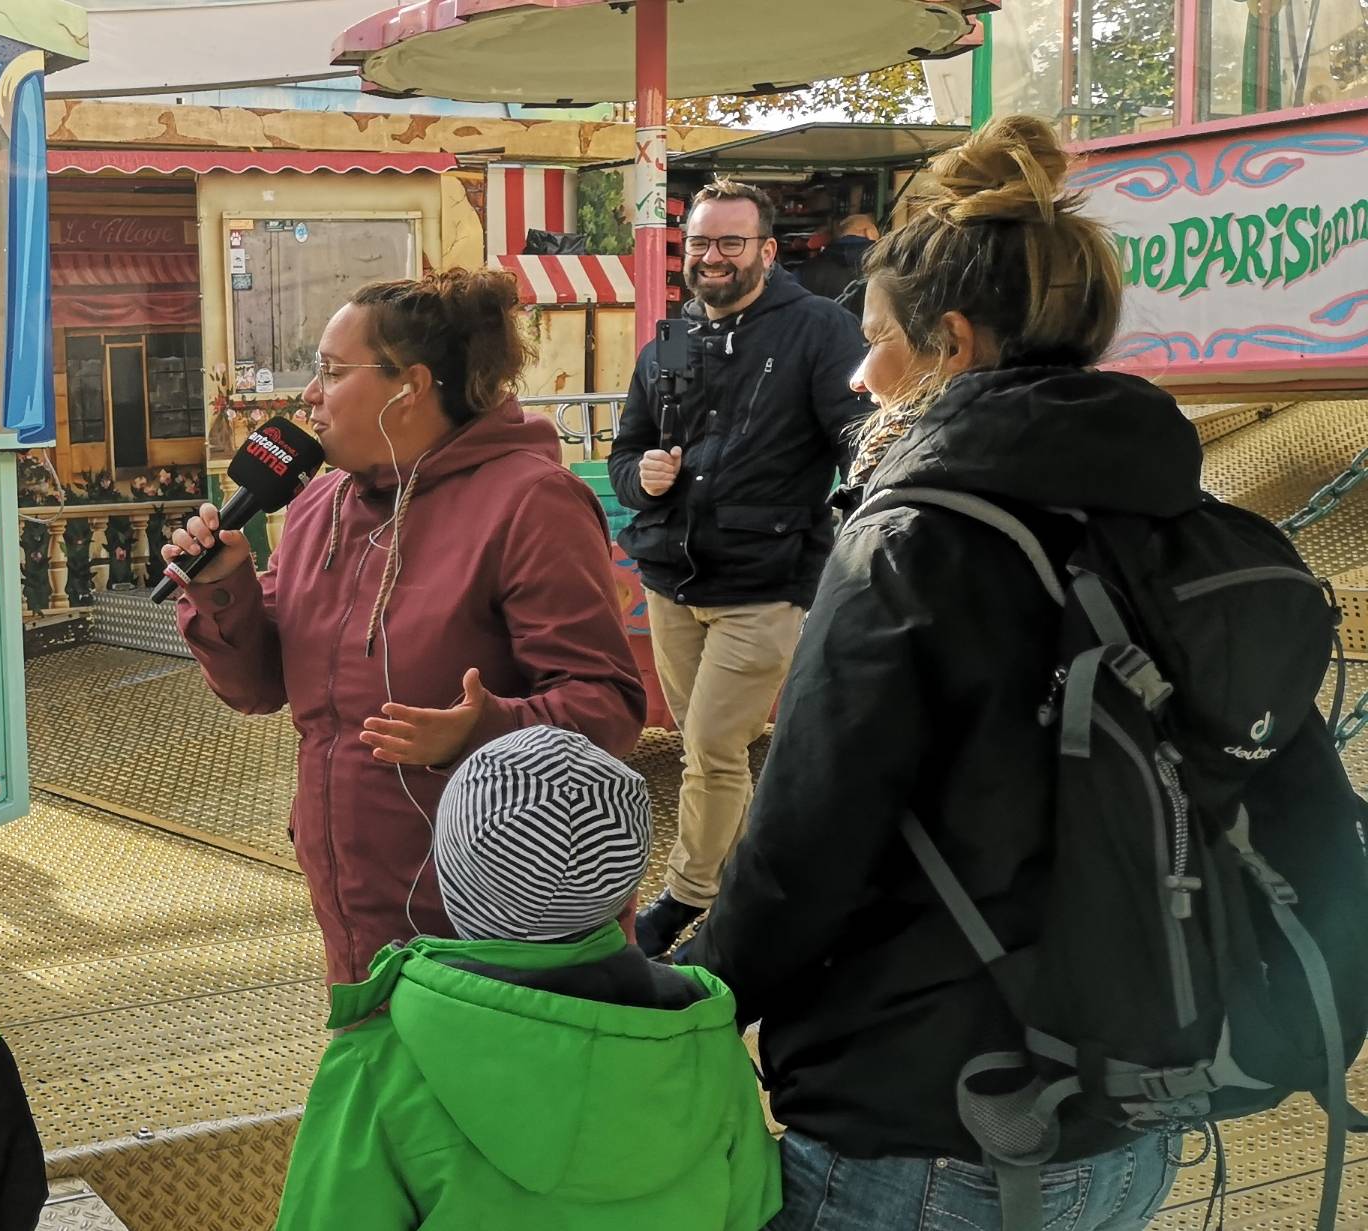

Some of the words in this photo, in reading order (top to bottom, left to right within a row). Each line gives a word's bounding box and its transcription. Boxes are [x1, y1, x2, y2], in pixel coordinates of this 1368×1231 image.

[92, 217, 176, 247] Village
[246, 442, 289, 477] unna
[248, 431, 294, 464] antenne
[1223, 745, 1277, 760] deuter
